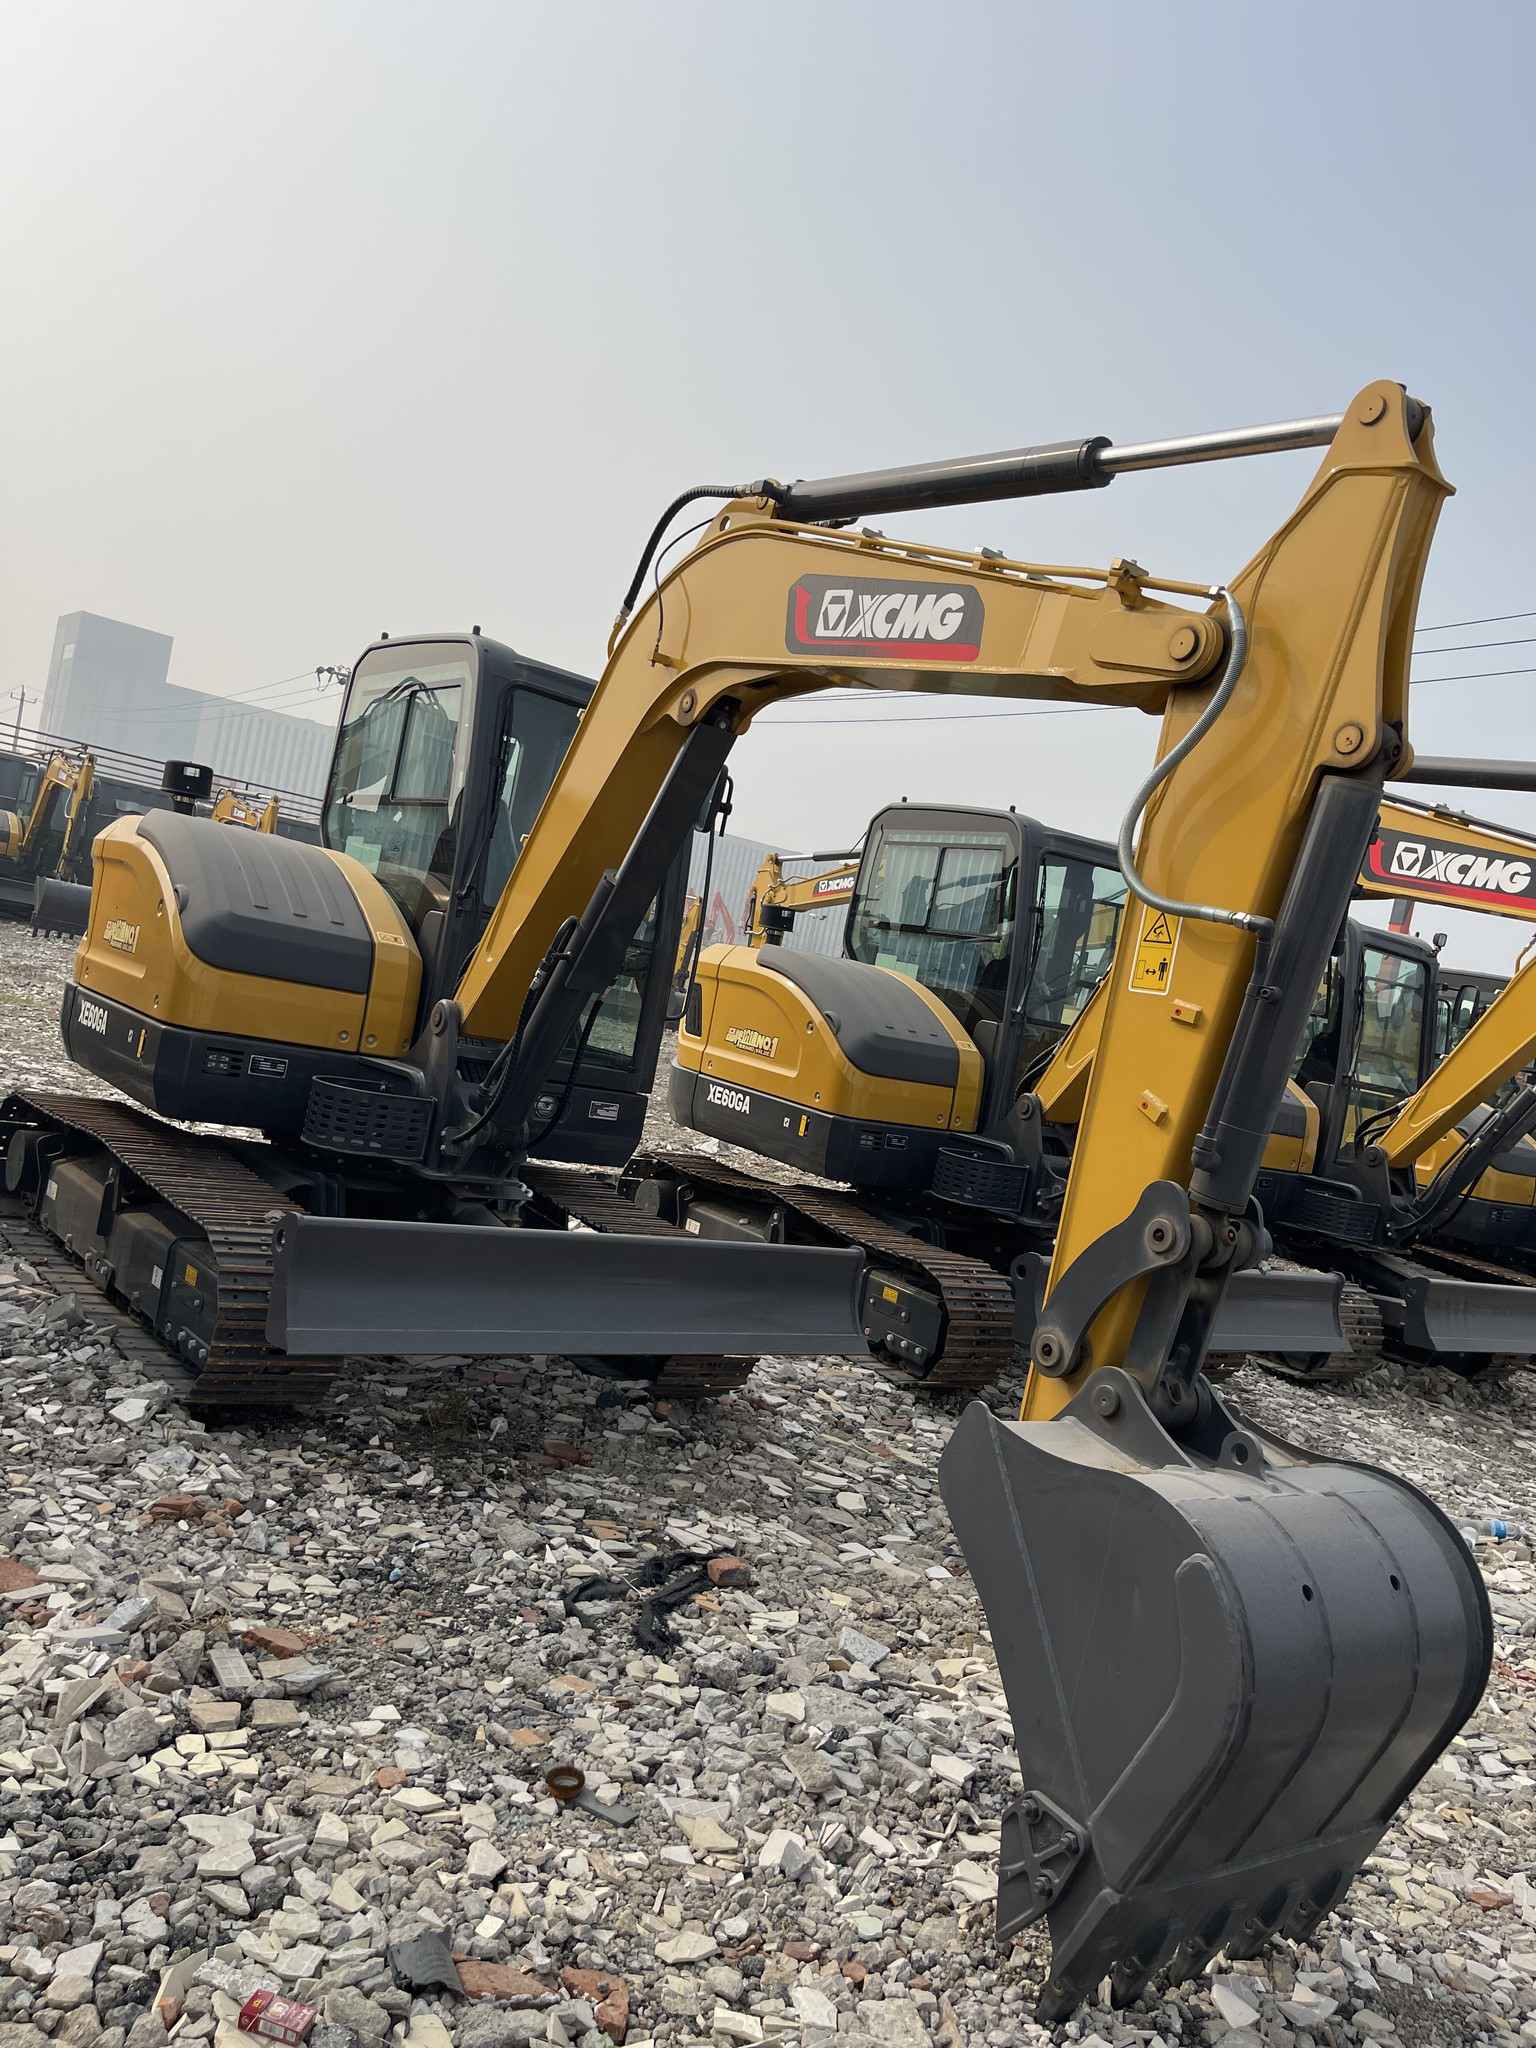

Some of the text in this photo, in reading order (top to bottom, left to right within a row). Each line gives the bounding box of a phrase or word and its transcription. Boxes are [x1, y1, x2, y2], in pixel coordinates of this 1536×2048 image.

[843, 593, 965, 640] XCMG
[1417, 849, 1532, 894] XCMG
[78, 1000, 108, 1035] XE60GA
[707, 1083, 751, 1115] XE60GA
